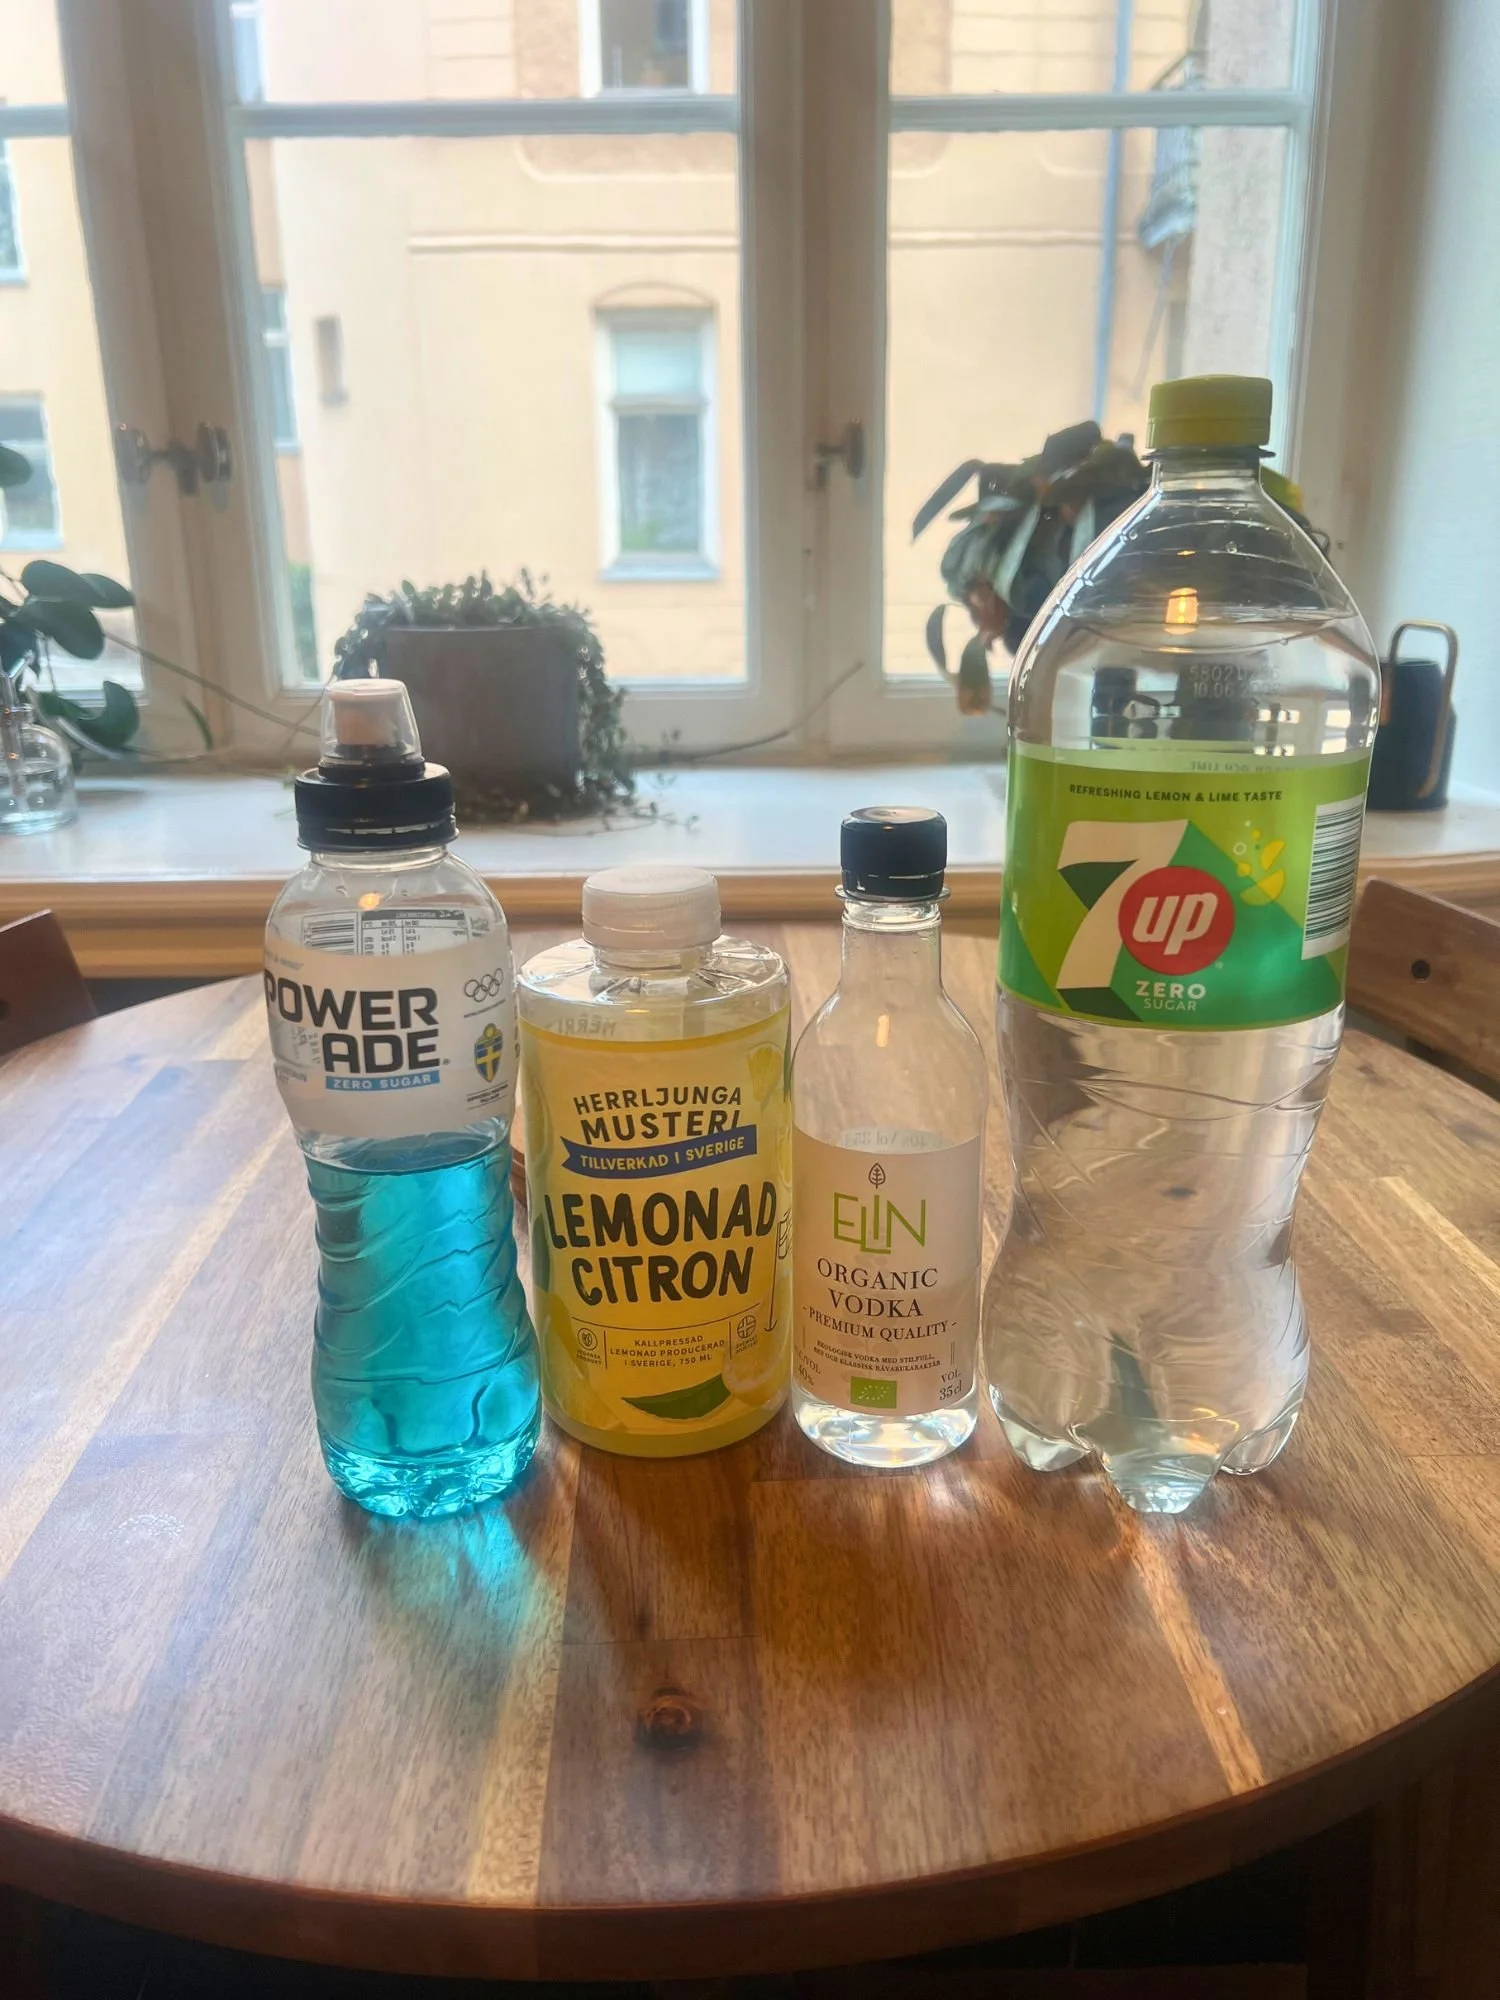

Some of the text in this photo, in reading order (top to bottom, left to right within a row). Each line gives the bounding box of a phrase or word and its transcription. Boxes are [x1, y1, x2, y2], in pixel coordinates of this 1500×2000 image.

[1069, 784, 1282, 802] REFRESHING LEMON & LIME TASTE
[264, 969, 439, 1030] POWER
[1135, 980, 1206, 999] ZERO
[1144, 998, 1197, 1011] SUGAR
[321, 1029, 440, 1074] ADE
[333, 1075, 432, 1090] ZERO SUGAR
[573, 1086, 742, 1115] HERRLJUNGA
[580, 1109, 741, 1145] MUSTERI
[580, 1136, 745, 1171] TILLVERKAD I SVERIGE
[544, 1181, 777, 1249] LEMONAD
[834, 1192, 926, 1255] ELIN
[571, 1246, 754, 1306] CITRON
[817, 1257, 938, 1290] ORGANIC
[828, 1288, 923, 1318] VODKA
[808, 1306, 948, 1342] PREMIUM QUALITY
[610, 1339, 725, 1358] LEMONAD PRODUCERAD
[634, 1334, 704, 1347] KALLPRESSAD
[630, 1358, 676, 1368] SVERIGE,
[679, 1356, 696, 1365] 750
[699, 1353, 712, 1362] ML
[839, 1358, 874, 1371] KLASSISK
[854, 1353, 880, 1363] VODKA
[939, 1379, 962, 1400] 35cl
